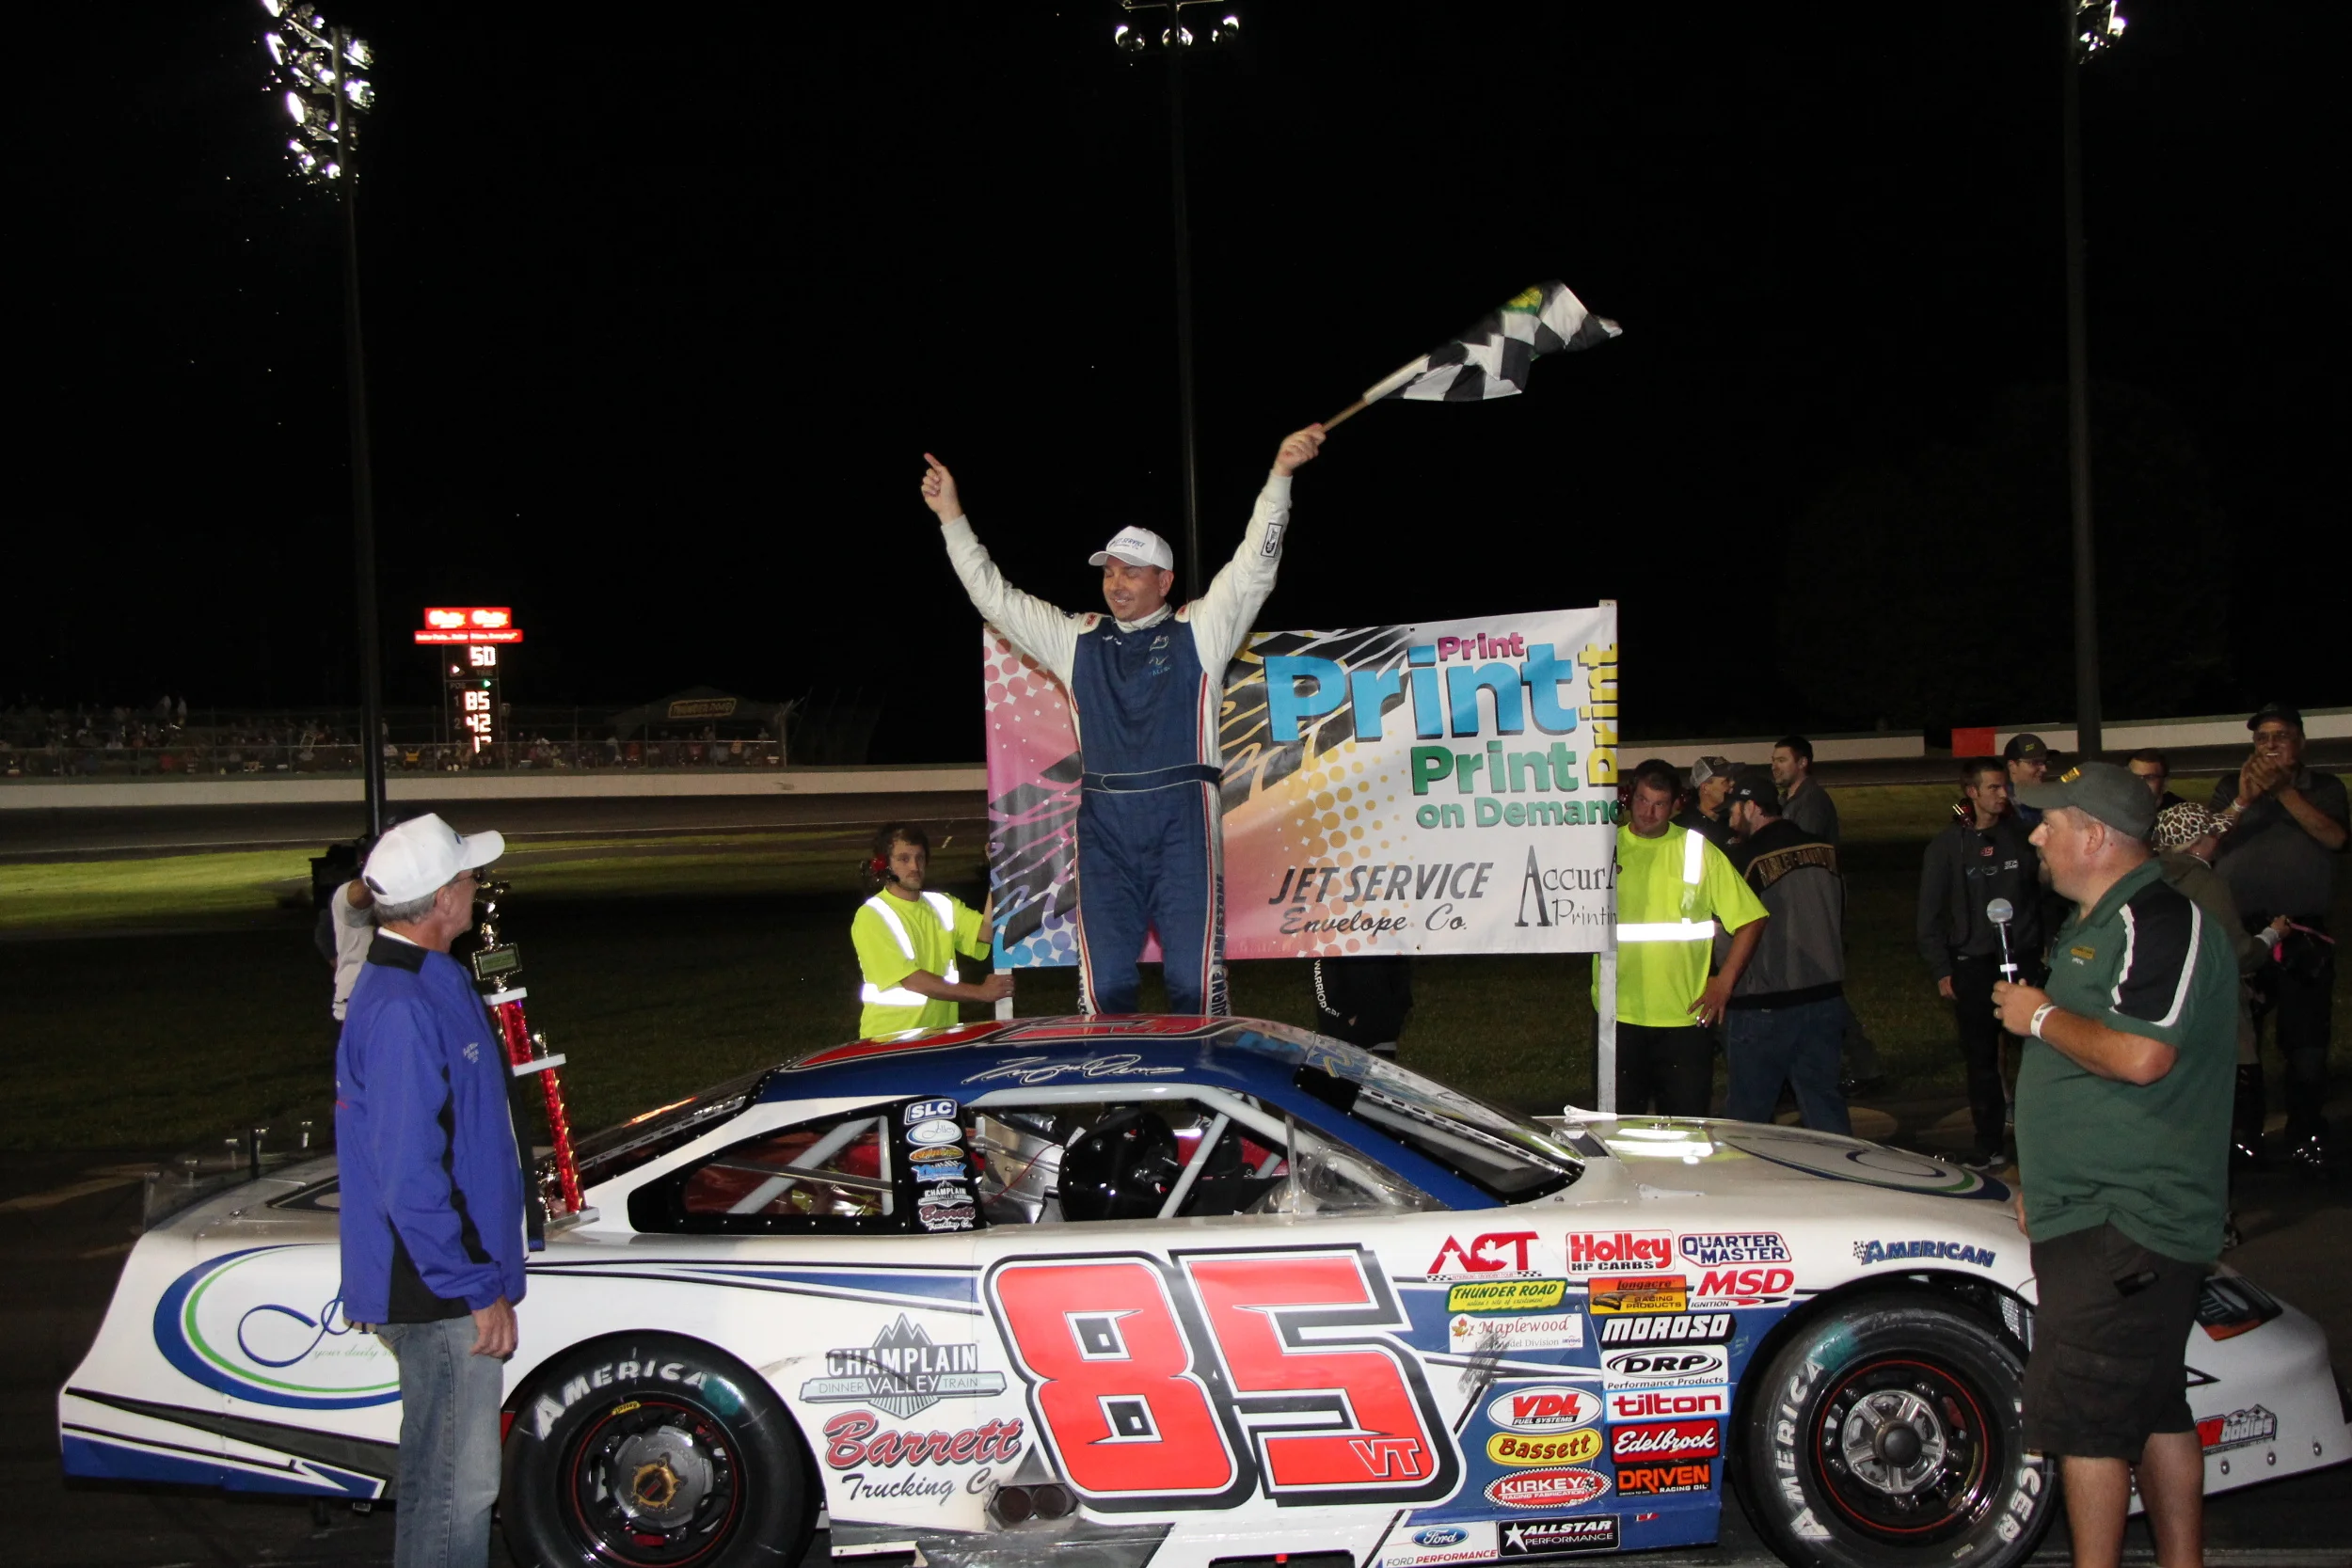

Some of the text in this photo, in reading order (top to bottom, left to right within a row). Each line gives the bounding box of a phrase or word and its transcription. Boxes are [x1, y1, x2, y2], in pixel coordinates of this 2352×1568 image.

[1123, 537, 1146, 547] SERVICE
[470, 645, 497, 666] 50
[1438, 632, 1524, 661] Print
[465, 690, 491, 711] 85
[1263, 642, 1578, 743] Print
[466, 713, 492, 733] 42
[1579, 643, 1617, 786] Print
[1411, 740, 1579, 796] Print
[1416, 800, 1465, 829] on
[1269, 863, 1493, 905] JET SERVICE
[1213, 874, 1225, 965] LIMESTONE
[1280, 903, 1467, 935] Envelope Co.
[1552, 898, 1617, 927] Printin
[912, 1101, 952, 1118] SLC
[925, 1188, 966, 1197] CHAMPLAIN
[1427, 1231, 1539, 1275] ACT
[1570, 1233, 1671, 1269] Holley
[1682, 1234, 1778, 1256] QUARTER
[1700, 1247, 1785, 1264] MASTER
[1862, 1240, 1995, 1267] AMERICAN
[1571, 1260, 1654, 1271] HP CARBS
[1454, 1284, 1557, 1300] THUNDER ROAD
[1616, 1279, 1672, 1291] Longacre
[1697, 1268, 1794, 1296] MSD
[1691, 1300, 1730, 1308] IGNITION
[1477, 1315, 1572, 1338] Maplewood
[1601, 1314, 1732, 1343] MOROSO
[1524, 1338, 1559, 1348] Division
[312, 1349, 339, 1362] your
[829, 1345, 977, 1377] CHAMPLAIN
[1624, 1354, 1708, 1373] DRP
[818, 1375, 978, 1395] DINNER VALLEY TRAIN
[986, 1244, 1464, 1511] 85
[1608, 1376, 1724, 1390] Performance Products
[534, 1359, 708, 1442] AMERICA
[1512, 1393, 1581, 1418] VDL
[1613, 1393, 1722, 1417] tilton
[1514, 1416, 1574, 1426] FUEL SYSTEMS
[823, 1409, 1025, 1470] Barrett
[1499, 1433, 1590, 1459] Bassett
[1614, 1428, 1716, 1454] Edelbrock
[1348, 1437, 1421, 1477] VT
[841, 1472, 957, 1506] Trucking
[1501, 1477, 1582, 1494] KIRKEY
[1618, 1465, 1709, 1494] DRIVEN
[1534, 1490, 1585, 1498] FABRICATION
[1422, 1528, 1457, 1544] Ford
[1524, 1520, 1614, 1536] ALLSTAR
[1525, 1531, 1613, 1545] PERFORMANCE
[1386, 1549, 1498, 1567] FORD PERFORMANCE
